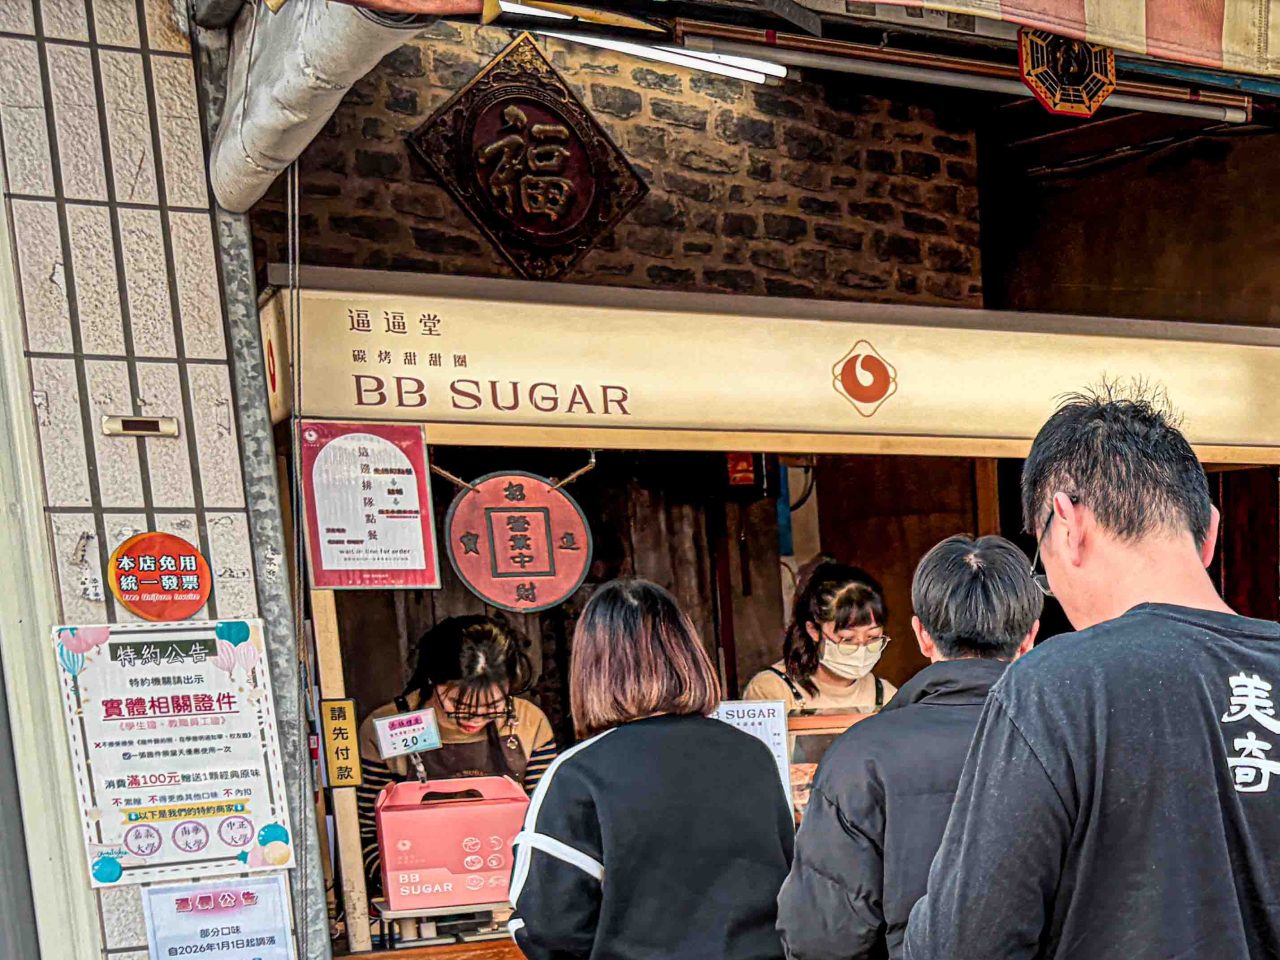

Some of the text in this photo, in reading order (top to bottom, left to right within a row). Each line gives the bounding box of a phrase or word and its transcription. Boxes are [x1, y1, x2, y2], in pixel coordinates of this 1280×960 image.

[478, 104, 576, 221] 福
[347, 308, 443, 337] 逼逼堂
[351, 348, 468, 369] 碳烤甜甜圈
[353, 373, 632, 416] BB SUGAR
[506, 515, 534, 569] 營業中
[117, 555, 198, 571] 本店免用
[119, 574, 200, 592] 統一發票
[115, 641, 210, 669] 特約公告
[102, 692, 239, 719] 實體相關證件
[725, 708, 776, 720] SUGAR
[330, 706, 354, 781] 請先付款
[400, 873, 420, 884] BB
[400, 883, 453, 896] SUGAR
[200, 925, 241, 939] 部分口味
